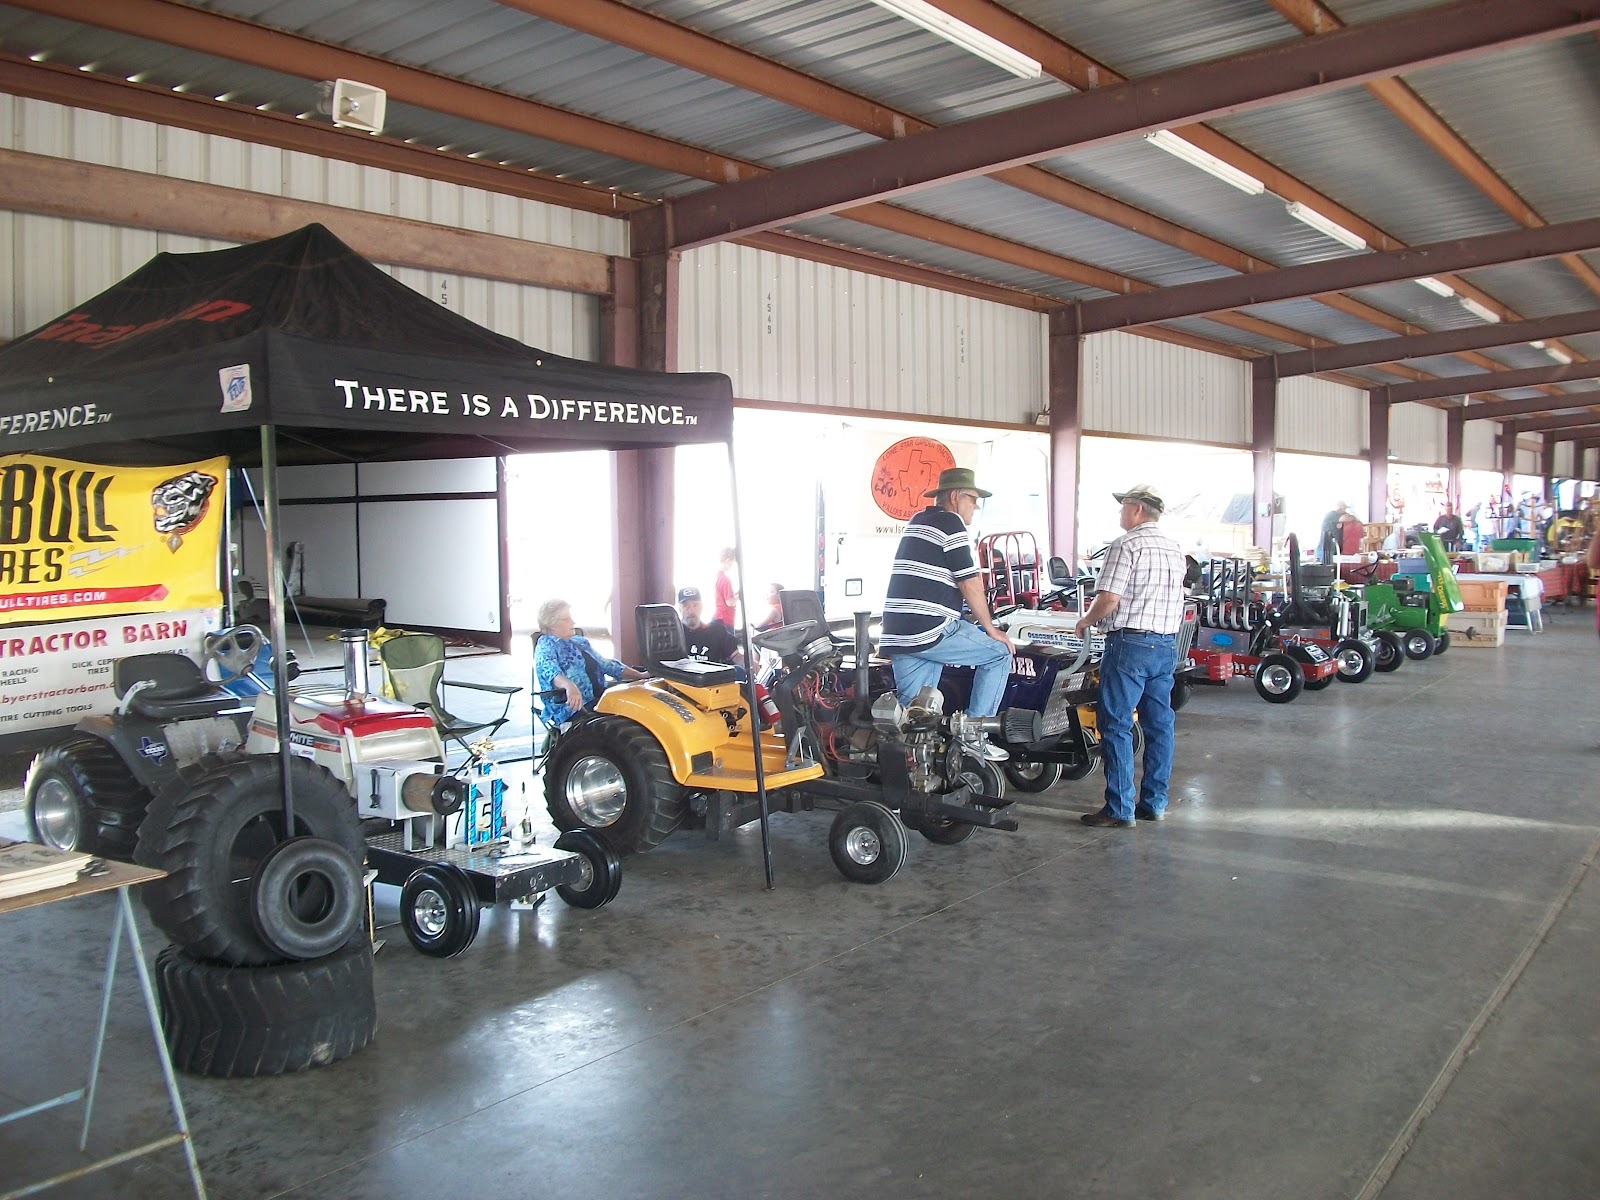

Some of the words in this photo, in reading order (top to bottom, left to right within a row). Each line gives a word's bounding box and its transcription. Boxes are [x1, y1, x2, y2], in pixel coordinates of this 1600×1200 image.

[333, 378, 450, 415] THERE
[460, 393, 491, 417] IS
[500, 396, 519, 418] A
[882, 446, 899, 462] LONE
[900, 439, 914, 451] STAR
[0, 463, 119, 545] BULL
[122, 619, 187, 644] BARN
[2, 667, 39, 678] RACING
[72, 661, 93, 669] DICK
[87, 666, 109, 675] TIRES
[23, 708, 62, 719] CUTTING
[66, 703, 93, 714] TOOLS
